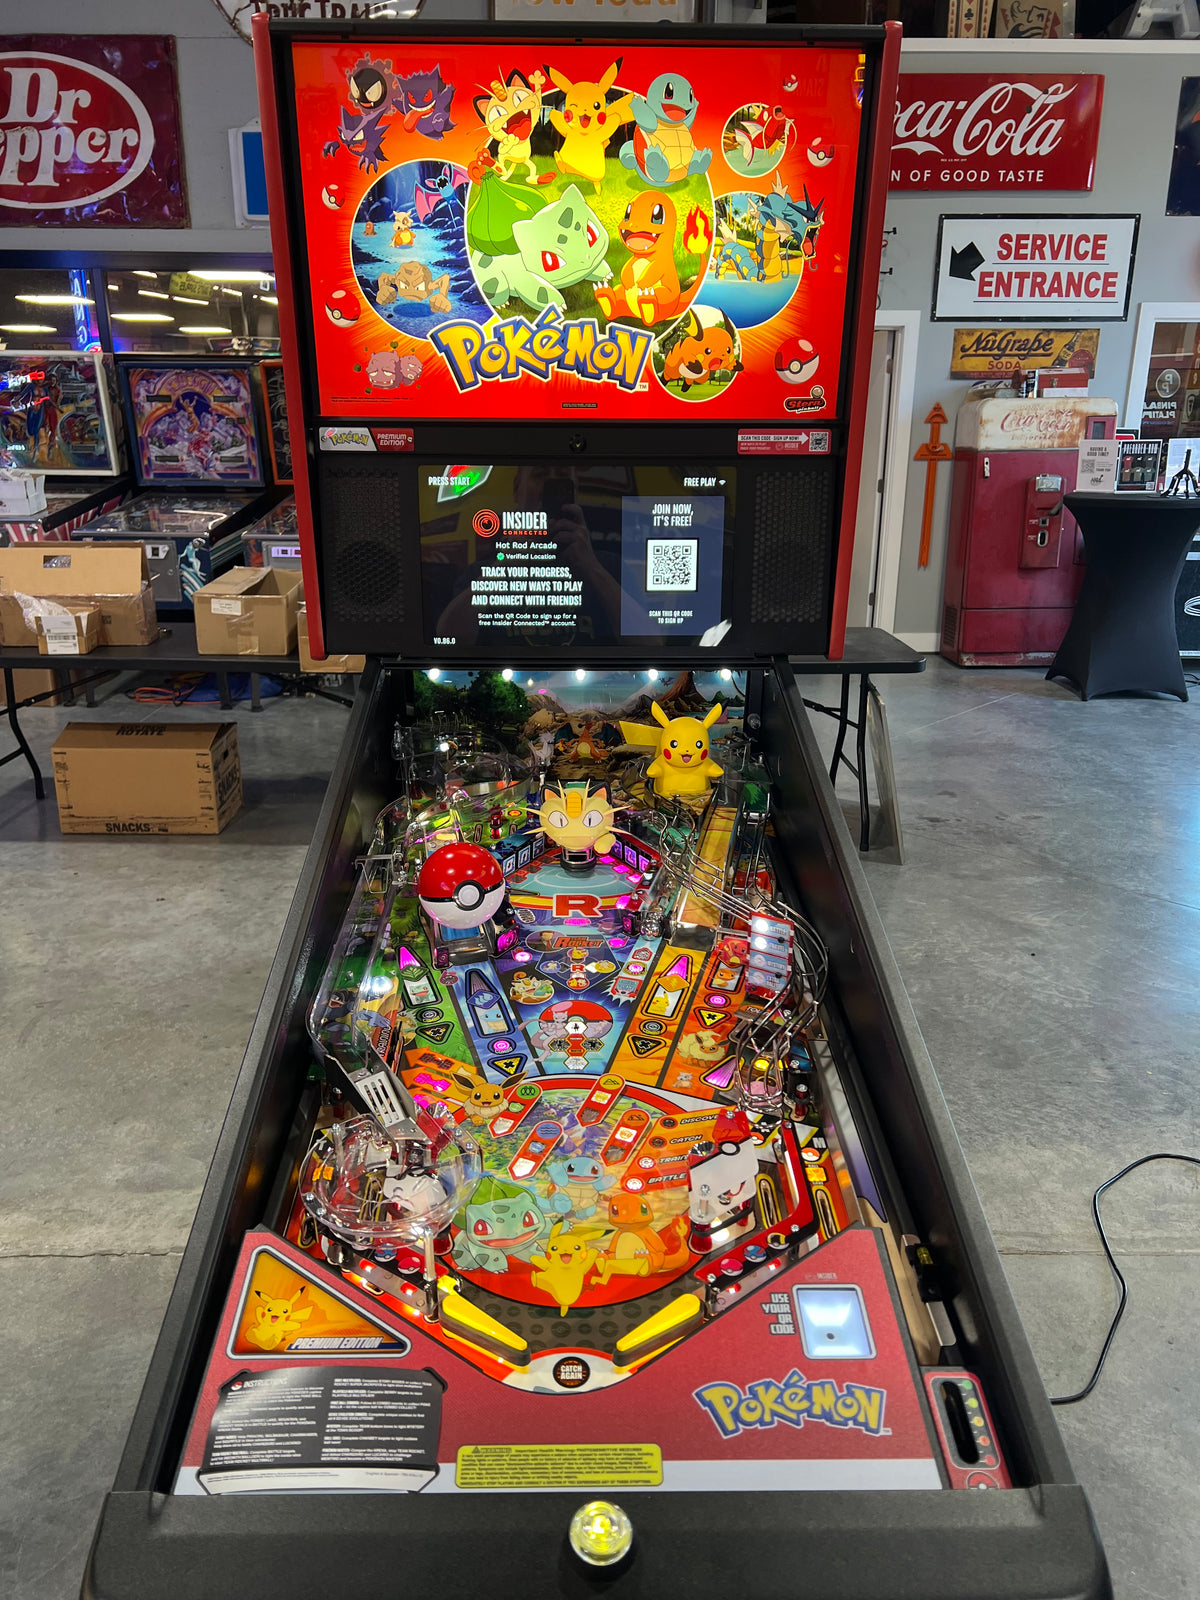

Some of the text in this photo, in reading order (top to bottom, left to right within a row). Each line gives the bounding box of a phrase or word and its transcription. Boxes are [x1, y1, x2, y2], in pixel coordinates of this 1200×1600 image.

[1, 67, 92, 124] Dr
[910, 169, 931, 182] OF
[940, 169, 990, 182] GOOD
[998, 169, 1045, 182] TASTE
[996, 233, 1108, 261] SERVICE
[977, 271, 1119, 298] ENTRANCE
[960, 330, 1054, 360] NuGrape
[987, 361, 1022, 370] SODA
[787, 399, 821, 409] Stern
[377, 433, 407, 441] PREMIUM
[428, 476, 470, 486] PRESS START
[684, 477, 716, 487] FREE PLAY
[652, 504, 694, 516] JOIN NOW,
[502, 511, 548, 529] INSIDER
[653, 516, 692, 527] IT'S FREE!
[481, 566, 572, 579] TRACK YOUR PROGRESS,
[471, 581, 583, 592] DISCOVER NEW WAYS TO PLAY
[471, 595, 582, 606] AND CONNECT WITH FRIENDS!
[673, 610, 680, 618] QR
[105, 822, 151, 833] SNACKS
[553, 893, 602, 918] R
[553, 936, 604, 948] ROCKET
[571, 964, 585, 972] R
[670, 1133, 703, 1144] CATCH
[659, 1154, 689, 1164] TRAIN
[647, 1172, 687, 1184] BATTLE
[771, 1293, 789, 1303] USE
[762, 1304, 791, 1313] YOUR
[778, 1314, 793, 1323] QR
[770, 1324, 795, 1335] CODE
[290, 1337, 384, 1349] PREMIUM EDITION
[560, 1372, 583, 1380] AGAIN
